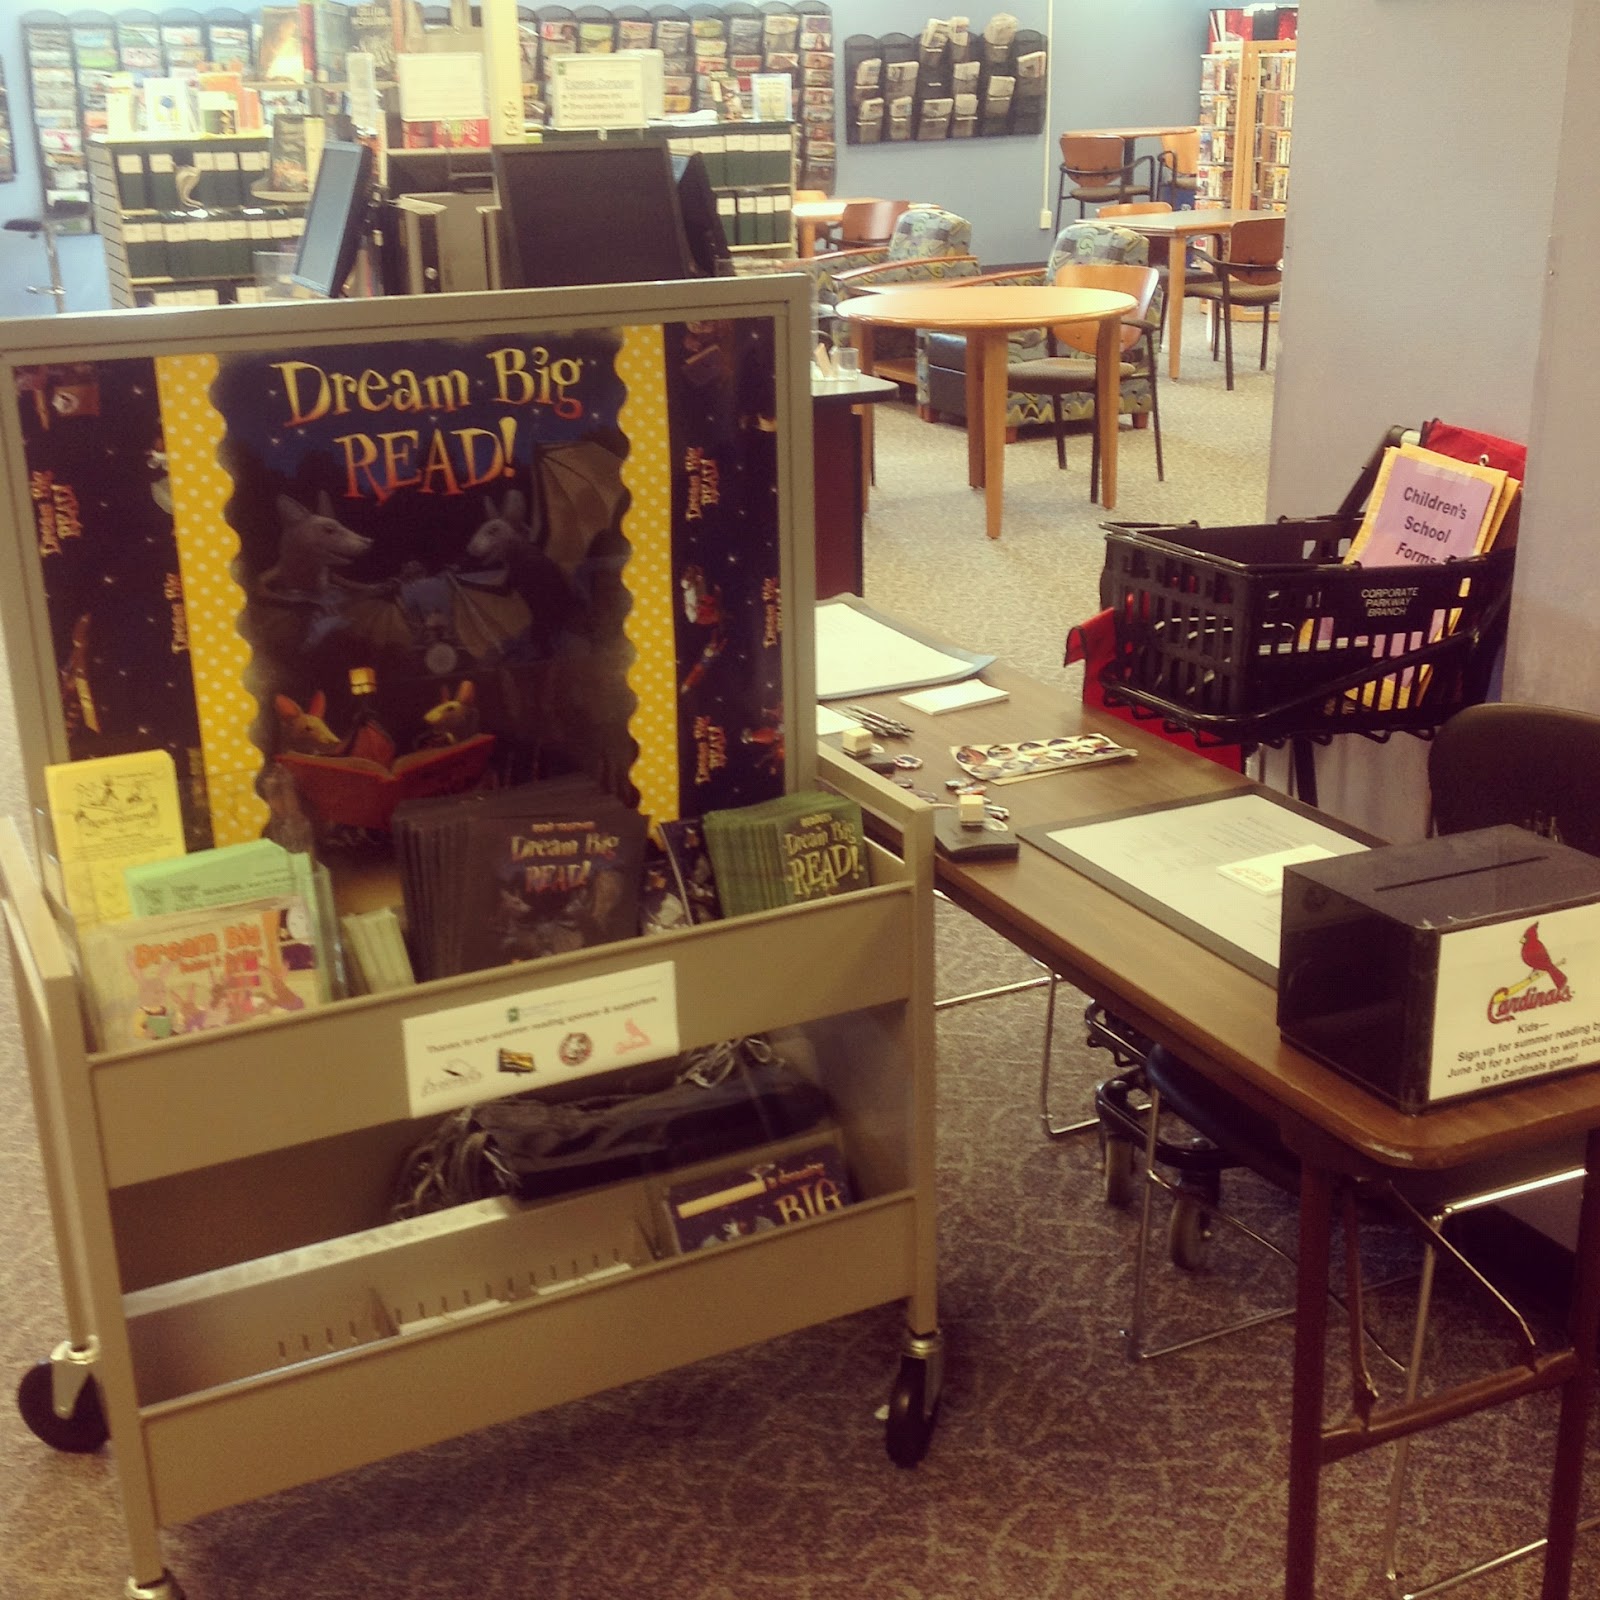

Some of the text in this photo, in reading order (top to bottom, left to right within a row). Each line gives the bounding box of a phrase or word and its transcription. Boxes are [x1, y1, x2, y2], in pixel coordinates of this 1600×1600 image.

[269, 346, 584, 427] Dream Big
[332, 416, 518, 508] READ!
[1402, 486, 1468, 520] Children's
[1404, 515, 1452, 543] School
[1394, 541, 1437, 565] Forms
[1361, 587, 1419, 598] CORPORATE
[1365, 597, 1411, 608] PARKWAY
[1367, 607, 1406, 617] BRANCH
[783, 829, 829, 857] Dream
[786, 843, 860, 898] READ!
[1487, 986, 1573, 1024] Cardinals
[1457, 1049, 1480, 1062] Sign
[1483, 1046, 1495, 1057] up
[1498, 1042, 1511, 1053] for
[1514, 1034, 1553, 1049] summer
[1555, 1024, 1590, 1041] reading
[1447, 1066, 1472, 1078] June
[1475, 1061, 1486, 1072] 30
[1489, 1058, 1502, 1068] for
[1513, 1048, 1548, 1062] chance
[1550, 1045, 1560, 1054] to
[1563, 1041, 1579, 1051] win
[1481, 1074, 1490, 1084] to
[1501, 1061, 1547, 1079] Cardinals
[1550, 1053, 1578, 1070] game!
